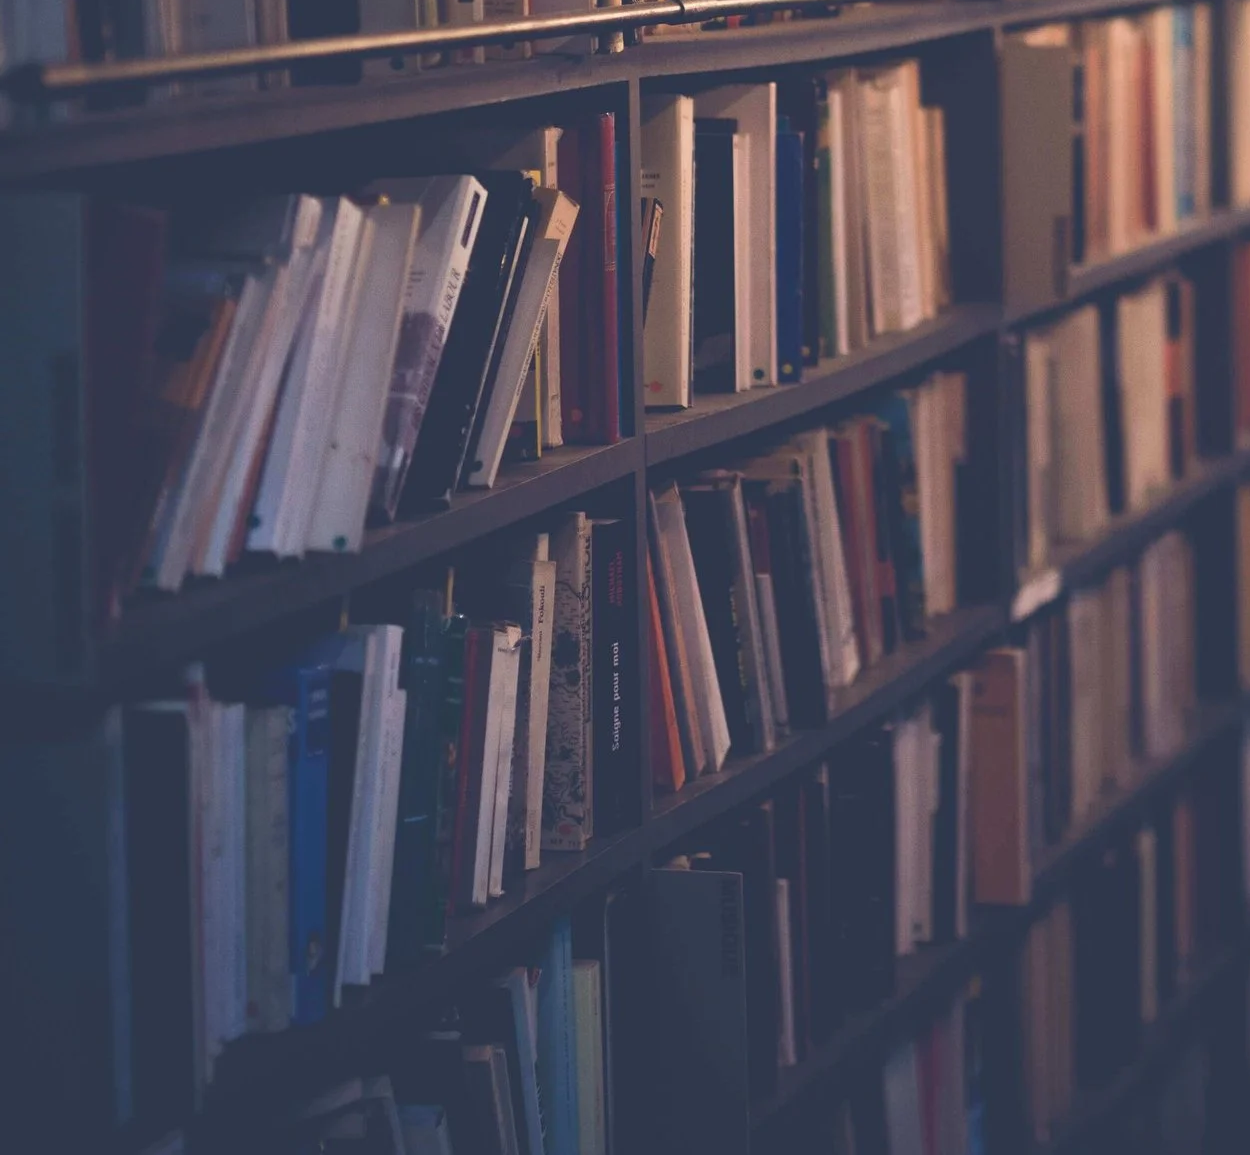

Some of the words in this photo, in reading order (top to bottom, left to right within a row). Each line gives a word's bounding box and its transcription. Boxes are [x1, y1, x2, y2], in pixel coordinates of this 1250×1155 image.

[611, 641, 619, 667] moi
[613, 672, 621, 701] pour
[611, 706, 621, 752] Saigne
